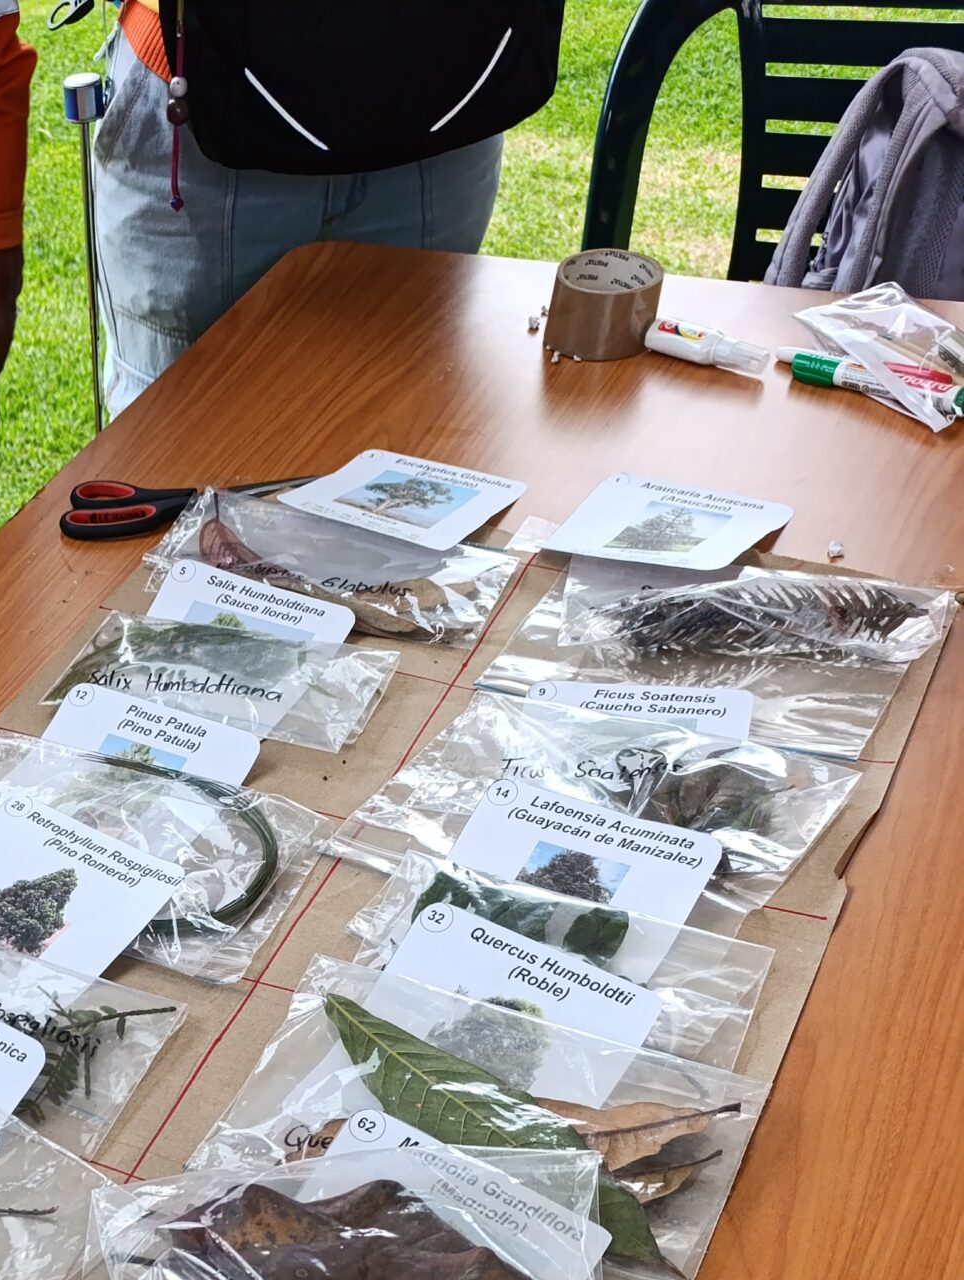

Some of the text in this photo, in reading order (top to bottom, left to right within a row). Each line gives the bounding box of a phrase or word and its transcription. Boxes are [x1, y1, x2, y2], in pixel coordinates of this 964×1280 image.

[395, 458, 513, 490] Eucalyptus Globulus
[660, 494, 733, 513] (Araucano)
[703, 493, 765, 511] Auracana
[179, 566, 188, 576] 5
[207, 575, 326, 618] Salix Humboldtiana
[215, 593, 304, 626] (Sauce llorón)
[75, 689, 88, 701] 12
[539, 688, 547, 696] 9
[594, 689, 716, 704] Ficus Soatensis
[125, 704, 207, 738] Pinus Patula
[579, 700, 727, 718] (Caucho Sabanero)
[117, 718, 202, 754] (Pino Patula)
[11, 801, 26, 811] 28
[494, 786, 511, 799] 14
[507, 806, 703, 869] (Guayacán de Manizalez)
[530, 795, 695, 850] Lafoensia Acuminata
[27, 811, 185, 887] Retrophyllum Rospigliosii
[43, 837, 142, 888] (Pino Romerón)
[427, 910, 445, 925] 32
[470, 927, 636, 1006] Quercus Humboldtii
[508, 965, 572, 1002] (Roble)
[358, 1117, 376, 1134] 62
[397, 1137, 583, 1242] Magnolia Grandiflora
